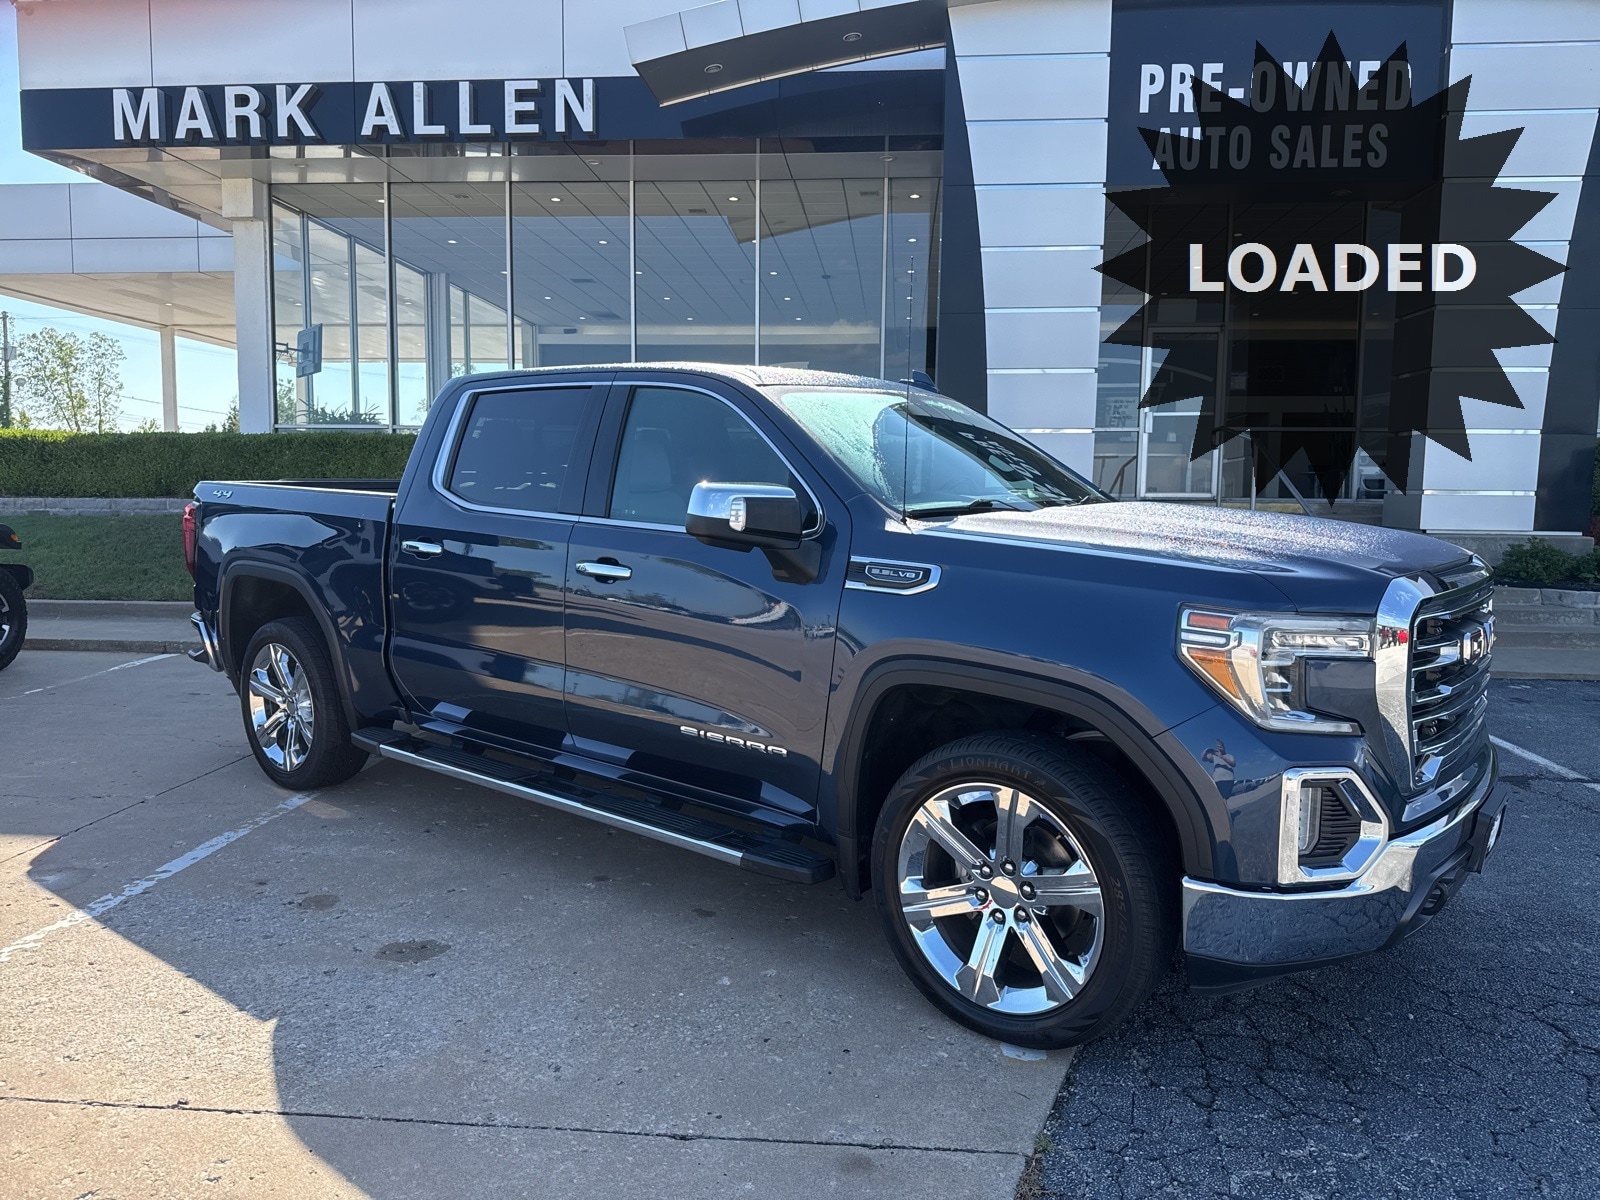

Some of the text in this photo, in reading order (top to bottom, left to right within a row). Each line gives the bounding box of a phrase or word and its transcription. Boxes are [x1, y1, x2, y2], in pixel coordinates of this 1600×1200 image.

[112, 78, 596, 142] MARK ALLEN
[1139, 60, 1413, 114] PRE-OWNED
[1152, 123, 1389, 171] AUTO SALES
[680, 725, 788, 758] SIERRA
[949, 756, 1033, 780] LIONHART
